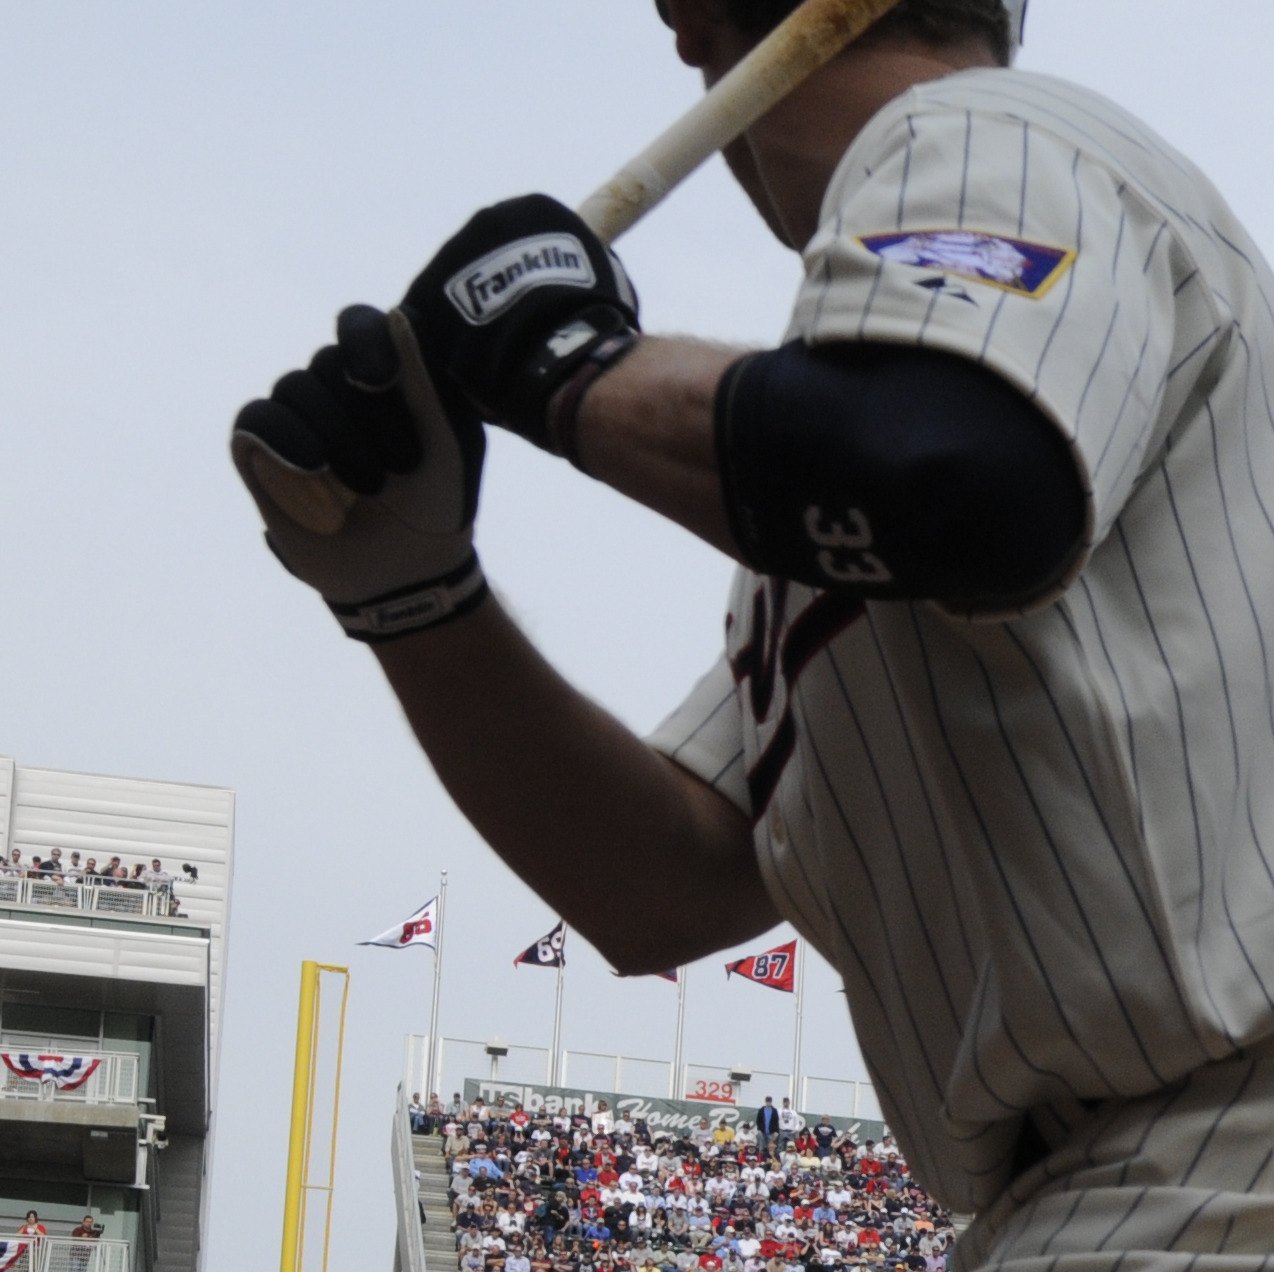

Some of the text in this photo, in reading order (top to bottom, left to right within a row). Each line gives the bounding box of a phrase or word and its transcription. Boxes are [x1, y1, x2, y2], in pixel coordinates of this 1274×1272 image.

[465, 242, 586, 311] Franklin
[804, 506, 892, 582] 33
[752, 953, 788, 979] 87
[693, 1078, 736, 1102] 329
